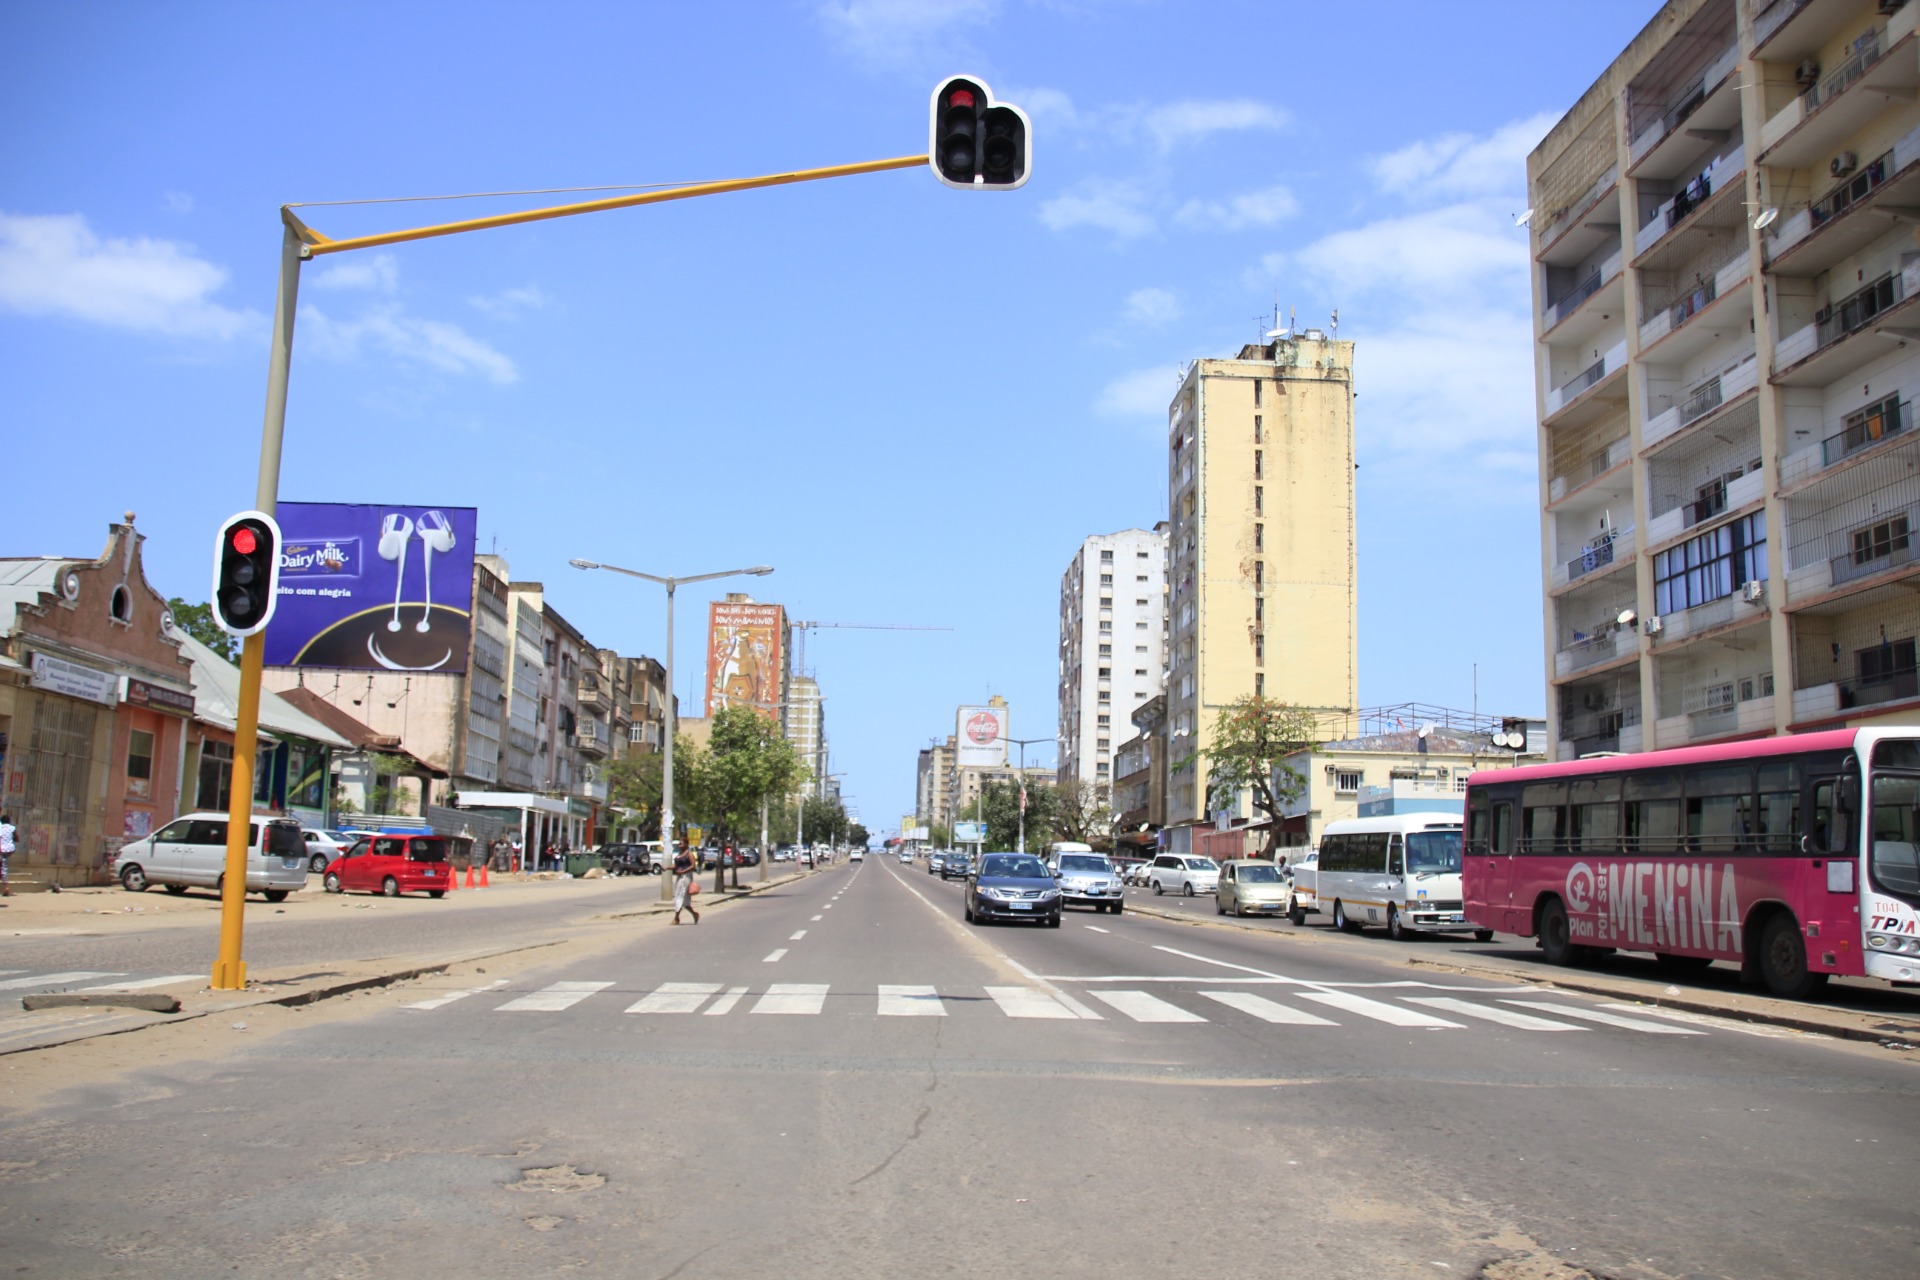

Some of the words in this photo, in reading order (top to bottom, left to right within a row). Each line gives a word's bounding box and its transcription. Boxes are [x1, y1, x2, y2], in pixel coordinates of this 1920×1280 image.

[280, 554, 315, 568] Dairy
[277, 586, 294, 595] eito
[319, 588, 351, 598] alegria
[1598, 862, 1608, 903] ser
[1569, 916, 1595, 938] Plan
[1598, 904, 1608, 940] por
